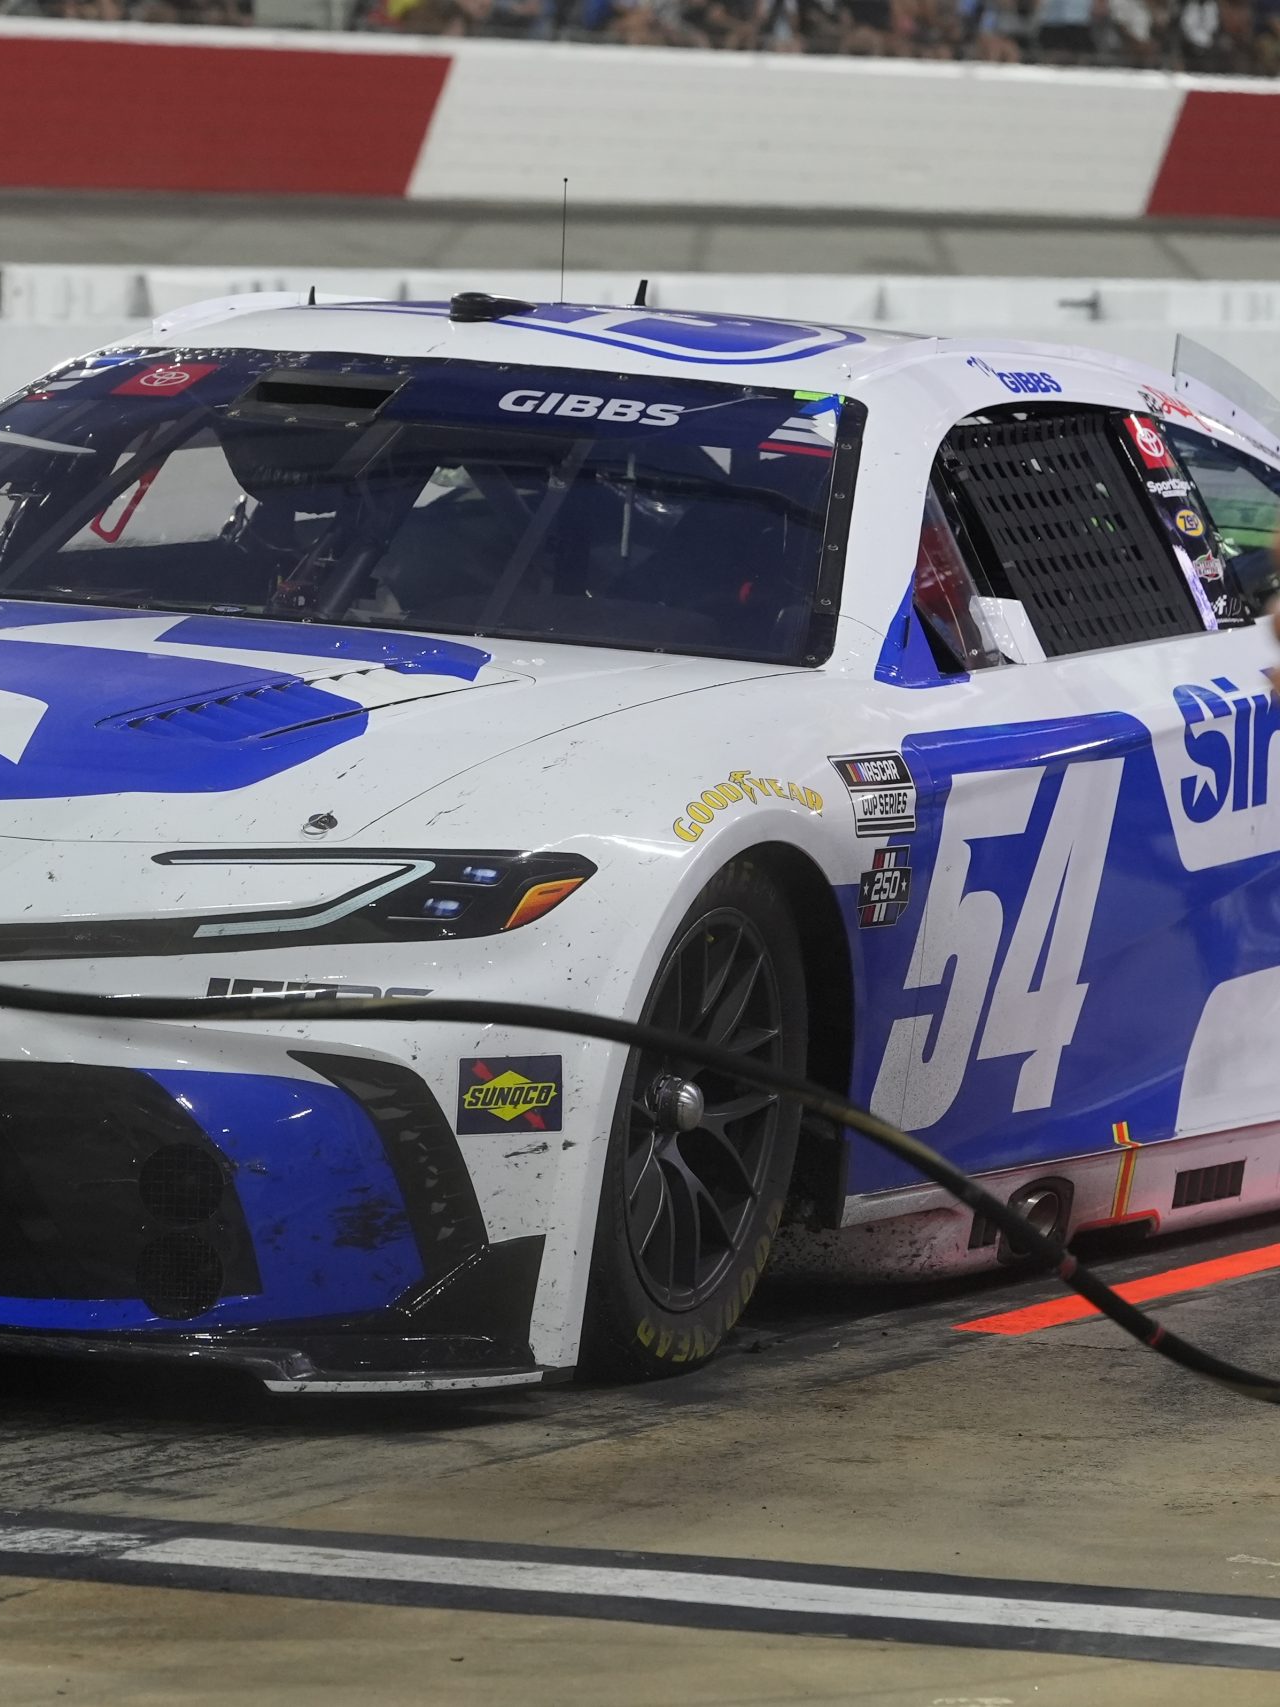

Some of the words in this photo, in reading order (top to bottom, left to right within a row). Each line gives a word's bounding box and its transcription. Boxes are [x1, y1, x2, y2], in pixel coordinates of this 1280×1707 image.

[997, 372, 1062, 393] GIBBS
[498, 390, 685, 427] GIBBS
[860, 759, 900, 782] NASCAR
[673, 770, 823, 842] GOODYEAR
[862, 794, 878, 816] CUP
[878, 792, 908, 815] SERIES
[871, 870, 901, 901] 250
[870, 757, 1124, 1132] 54
[466, 1085, 554, 1109] SUNOCO
